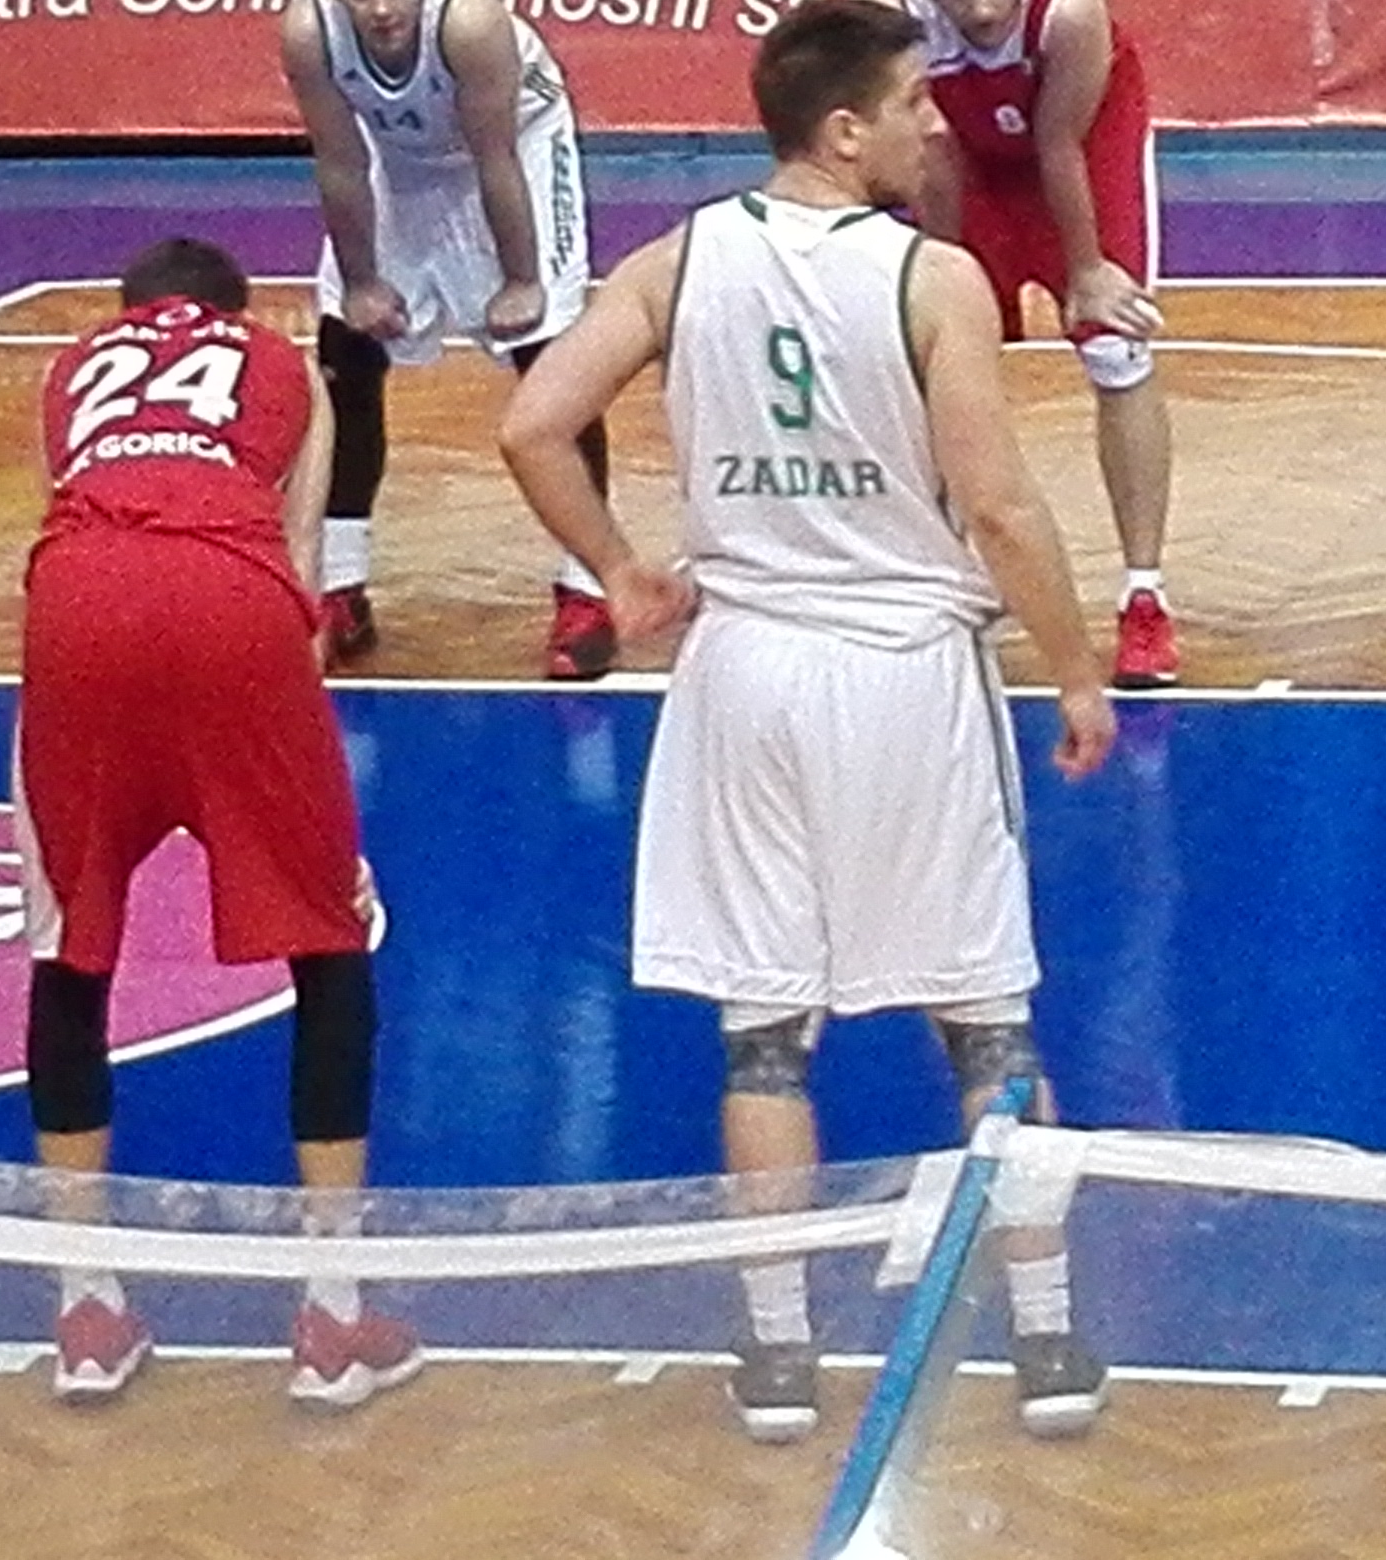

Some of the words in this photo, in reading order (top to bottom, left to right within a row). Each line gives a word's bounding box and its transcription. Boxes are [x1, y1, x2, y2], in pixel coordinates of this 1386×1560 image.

[66, 343, 245, 451] 24
[768, 324, 813, 429] 9
[95, 432, 236, 469] GORICA
[715, 455, 886, 498] ZADAR
